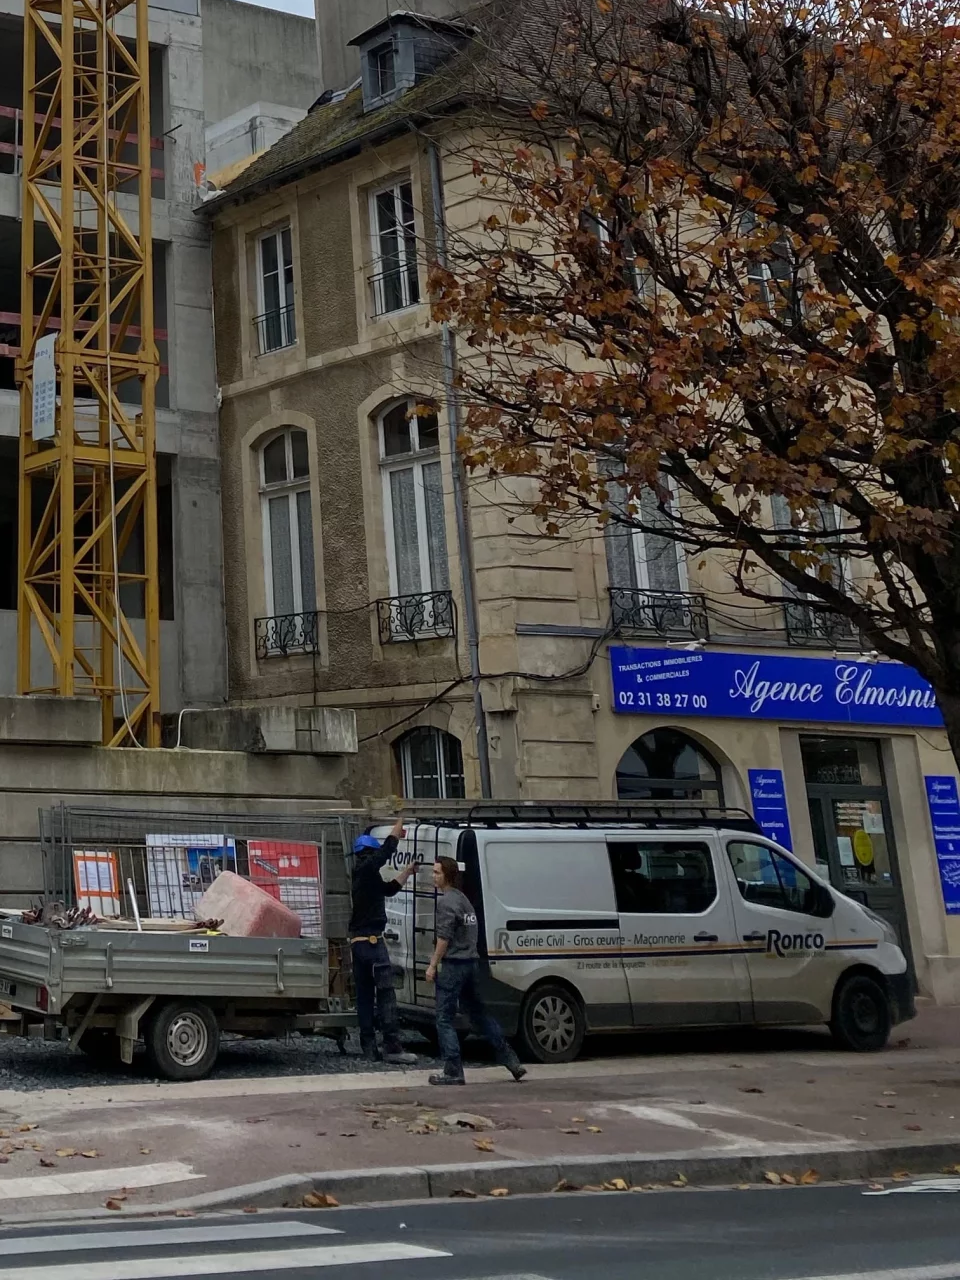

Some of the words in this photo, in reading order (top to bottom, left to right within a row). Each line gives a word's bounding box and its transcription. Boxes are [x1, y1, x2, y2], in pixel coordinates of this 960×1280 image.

[618, 660, 661, 672] TRANSACTIONS
[636, 674, 643, 683] &
[645, 669, 690, 682] COMMERCIALES
[729, 660, 824, 713] Agence
[619, 691, 635, 705] 02
[638, 692, 652, 706] 31
[656, 693, 671, 707] 38
[674, 694, 689, 708] 27
[692, 695, 708, 708] 00
[771, 832, 778, 840] &
[516, 934, 544, 947] Génie
[546, 934, 565, 947] Civil
[573, 934, 594, 947] Gros
[634, 932, 686, 948] Maçonnerie
[767, 929, 825, 958] Ronco
[585, 962, 602, 970] route
[603, 961, 611, 969] de
